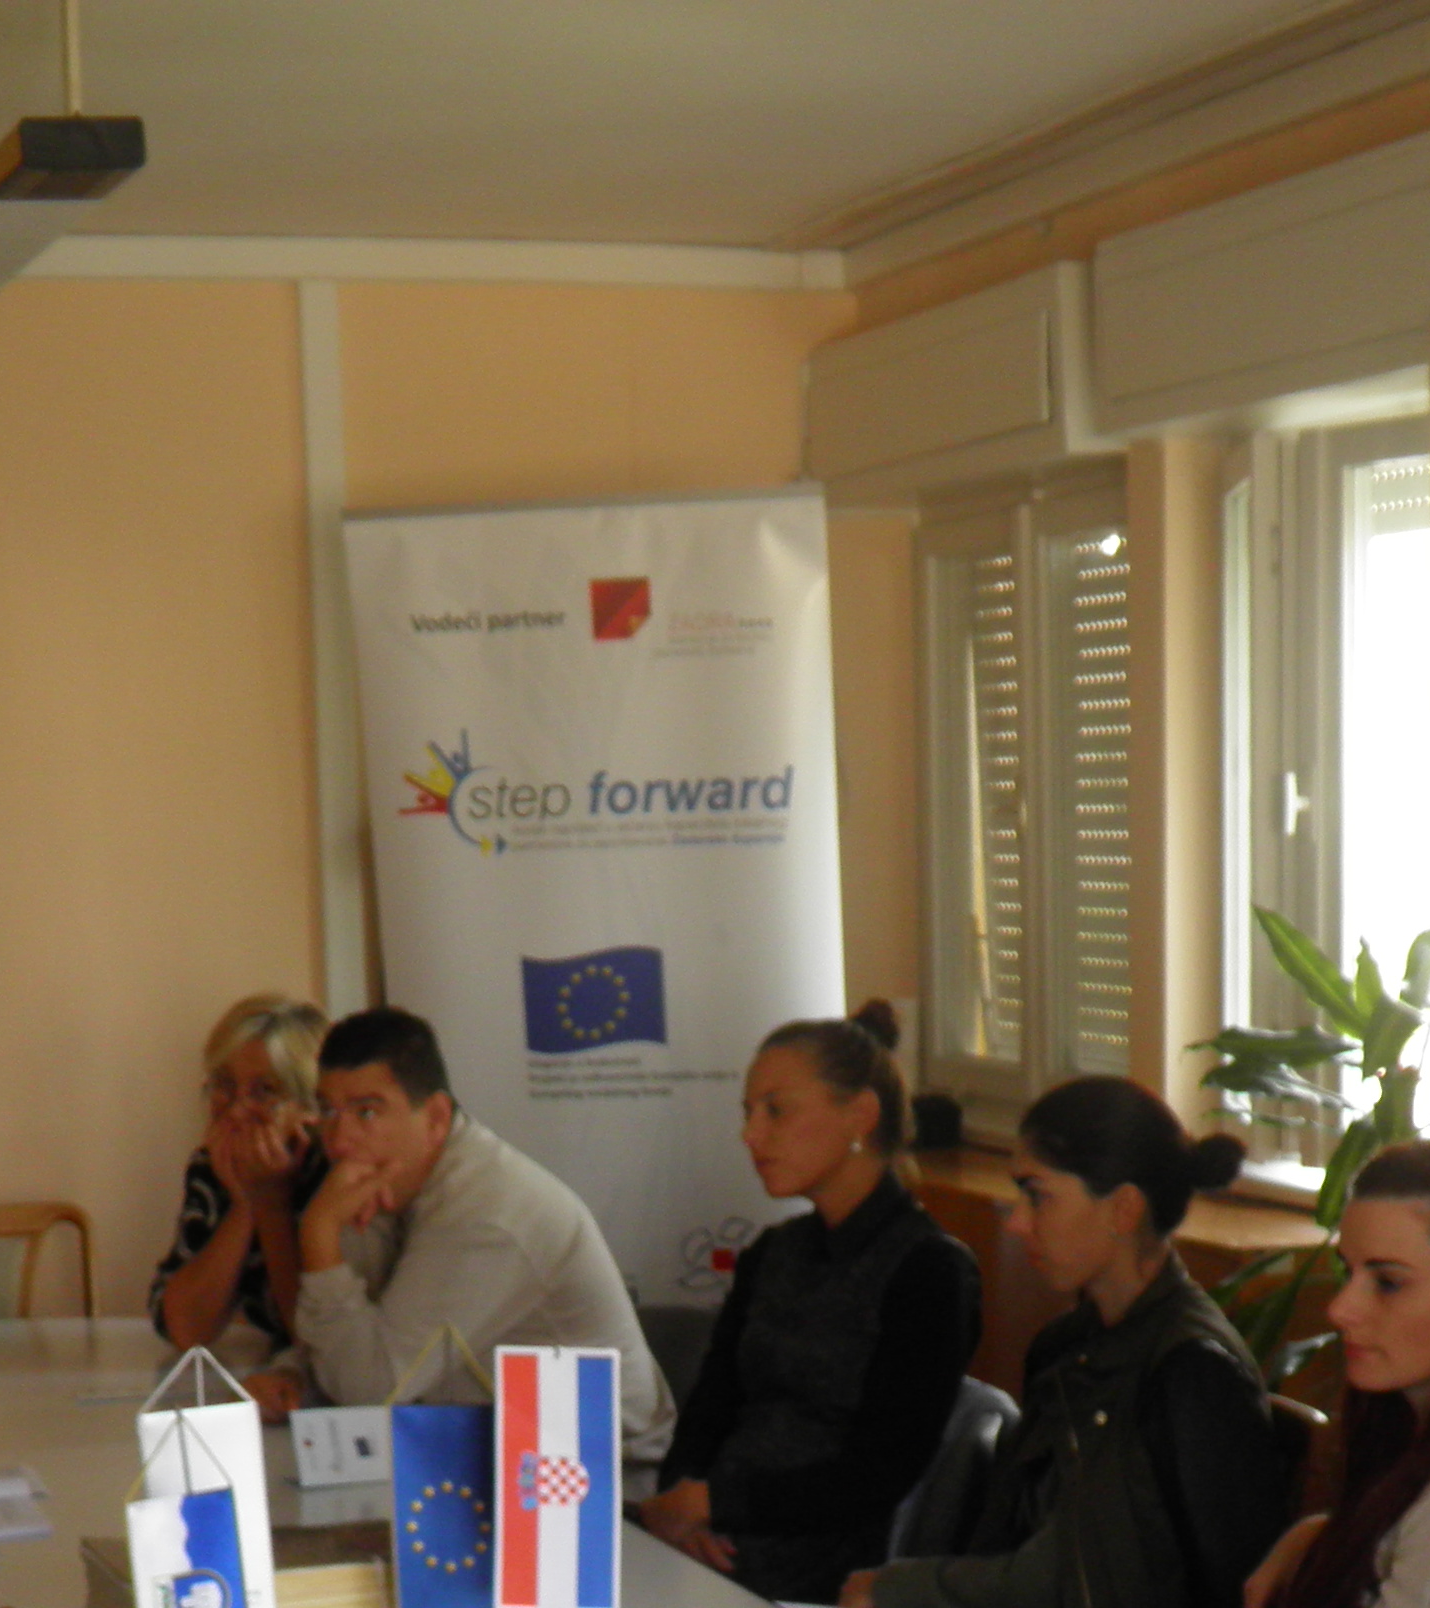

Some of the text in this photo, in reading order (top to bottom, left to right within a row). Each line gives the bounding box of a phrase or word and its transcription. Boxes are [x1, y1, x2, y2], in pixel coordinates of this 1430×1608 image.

[487, 609, 566, 632] partner
[469, 765, 793, 820] step forward
